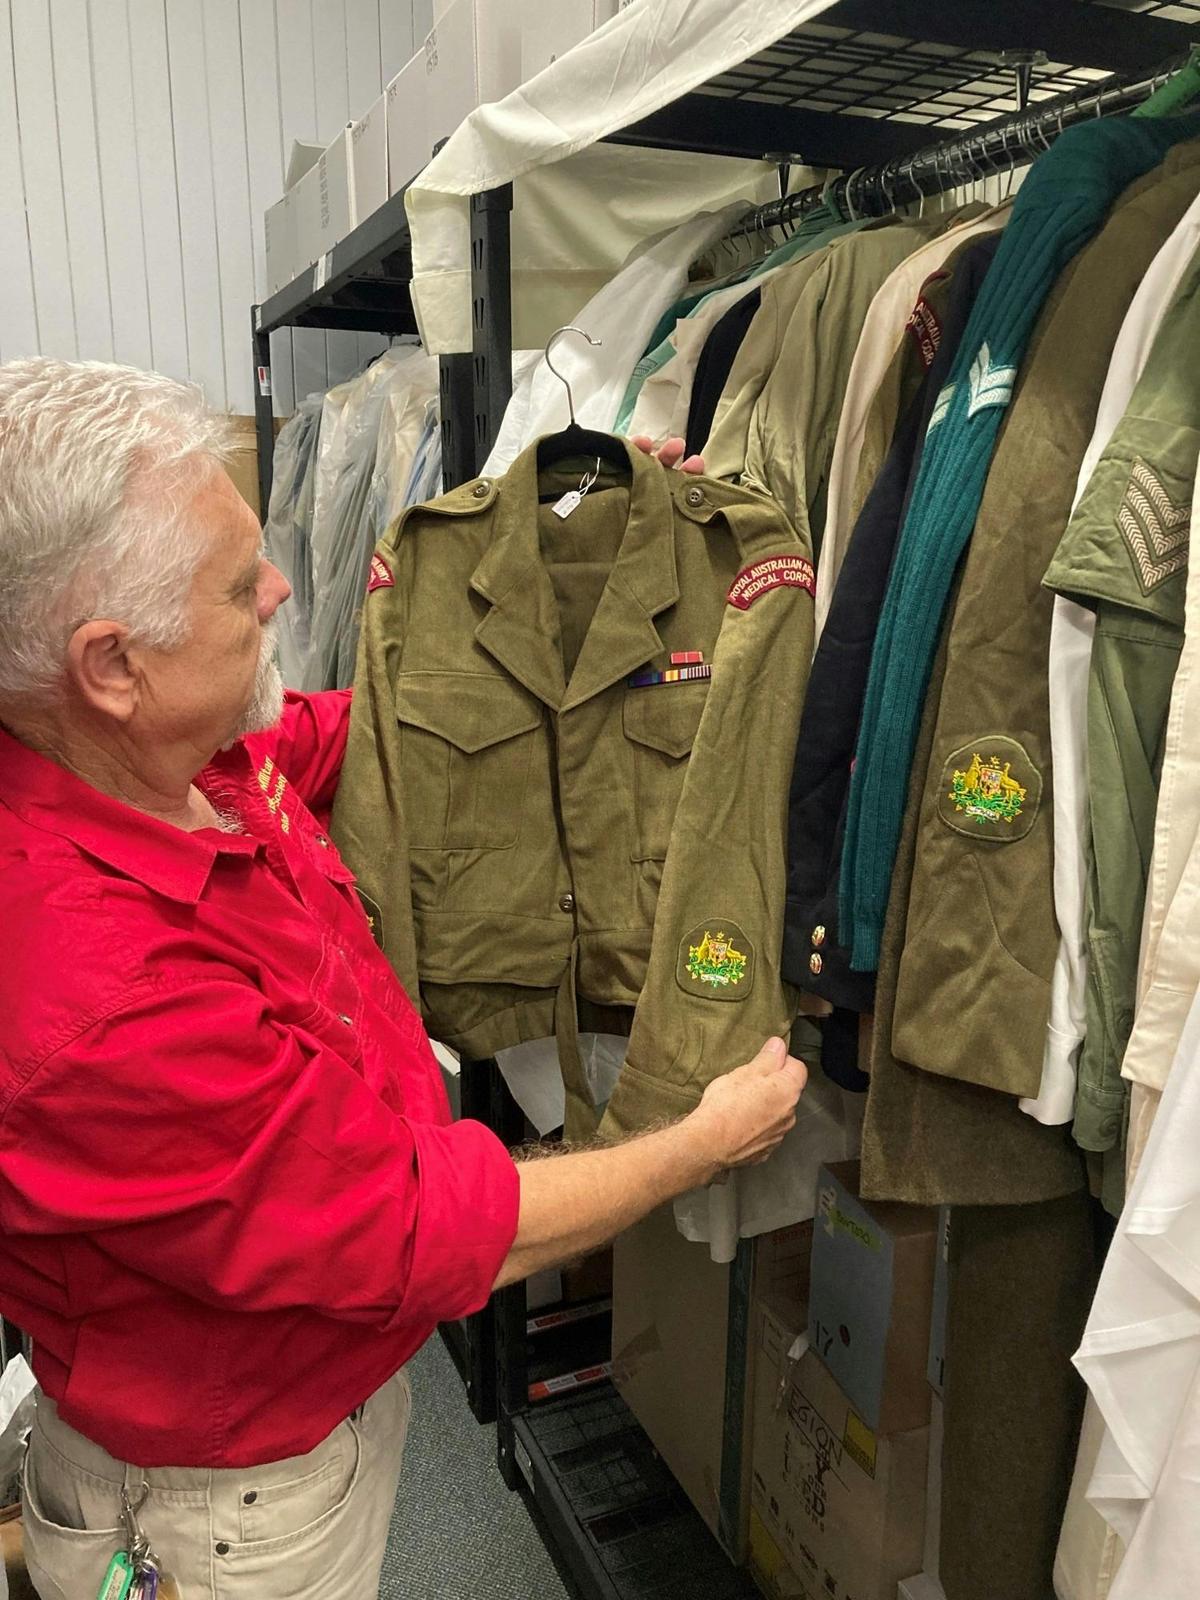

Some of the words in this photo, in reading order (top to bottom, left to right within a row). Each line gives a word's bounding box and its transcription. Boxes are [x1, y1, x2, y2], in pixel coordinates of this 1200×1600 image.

[729, 574, 753, 601] ROYAL
[750, 558, 803, 580] AUSTRALIAN
[741, 573, 781, 601] MEDICAL
[783, 570, 812, 587] CORPS
